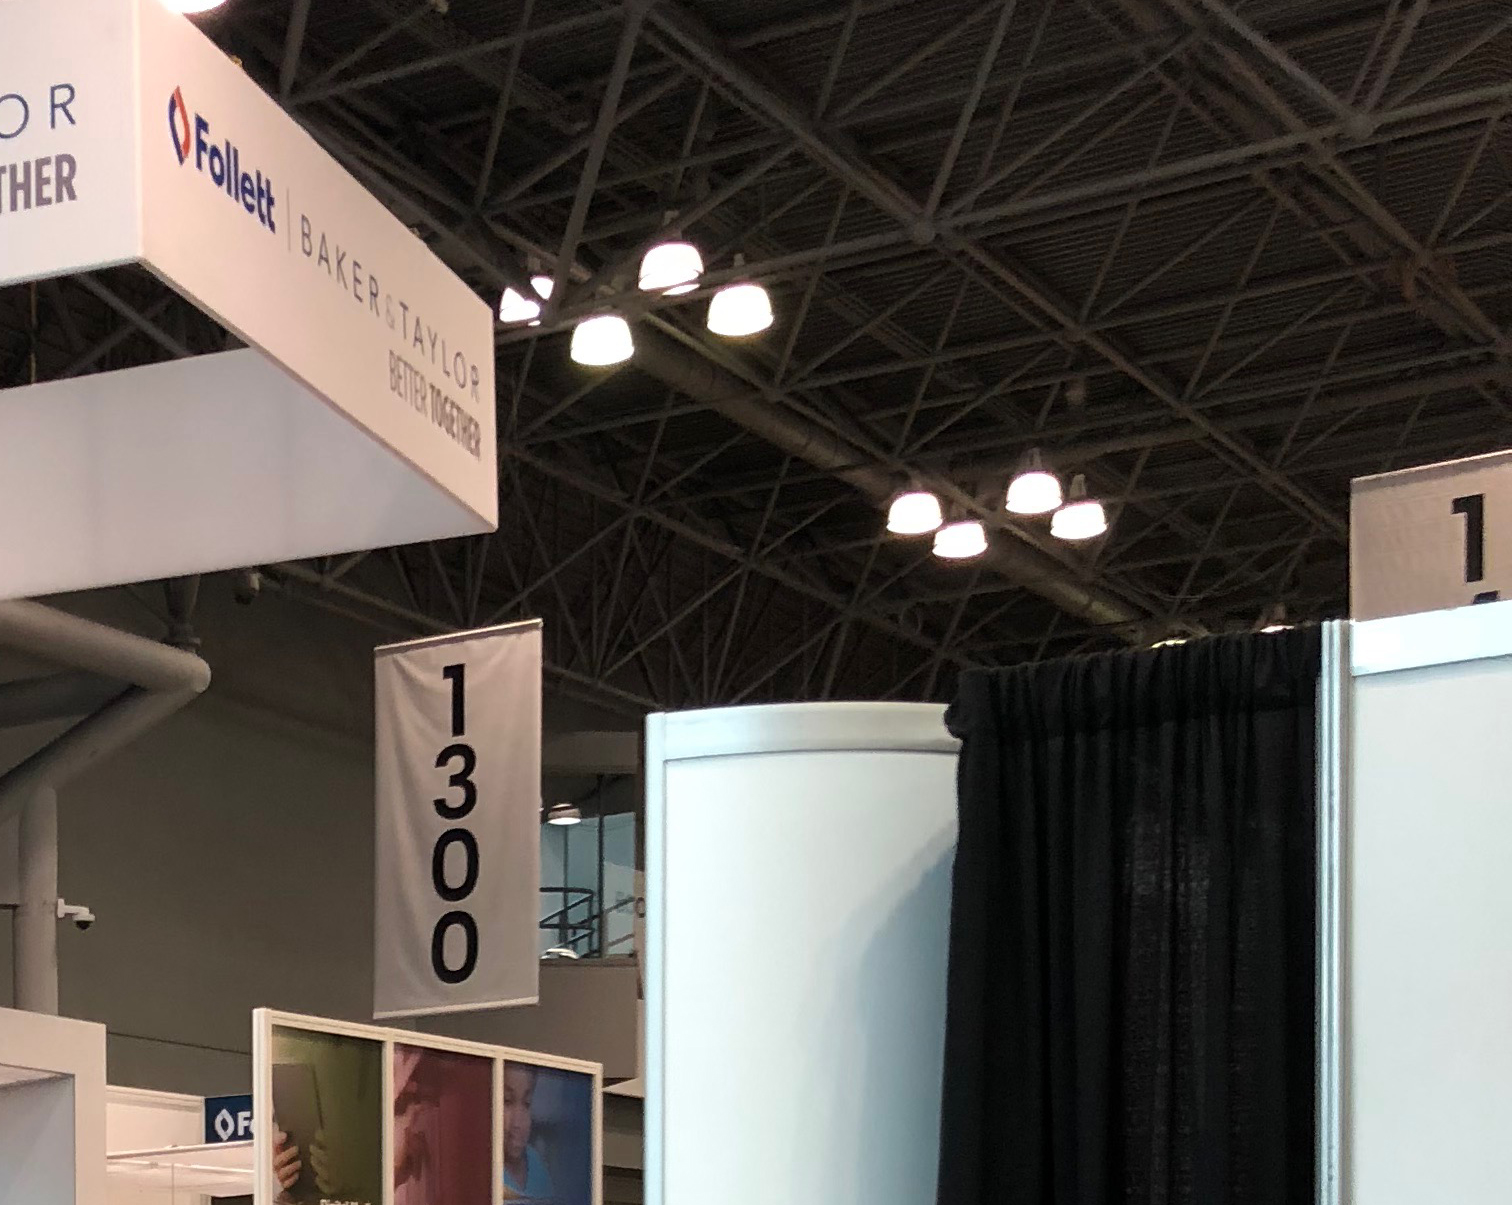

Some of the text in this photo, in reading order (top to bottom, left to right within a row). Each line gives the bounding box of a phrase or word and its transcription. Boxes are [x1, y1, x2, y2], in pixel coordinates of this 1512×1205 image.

[195, 112, 276, 234] Follett
[389, 349, 482, 462] BETTER TOGETHER
[430, 663, 480, 984] 1300
